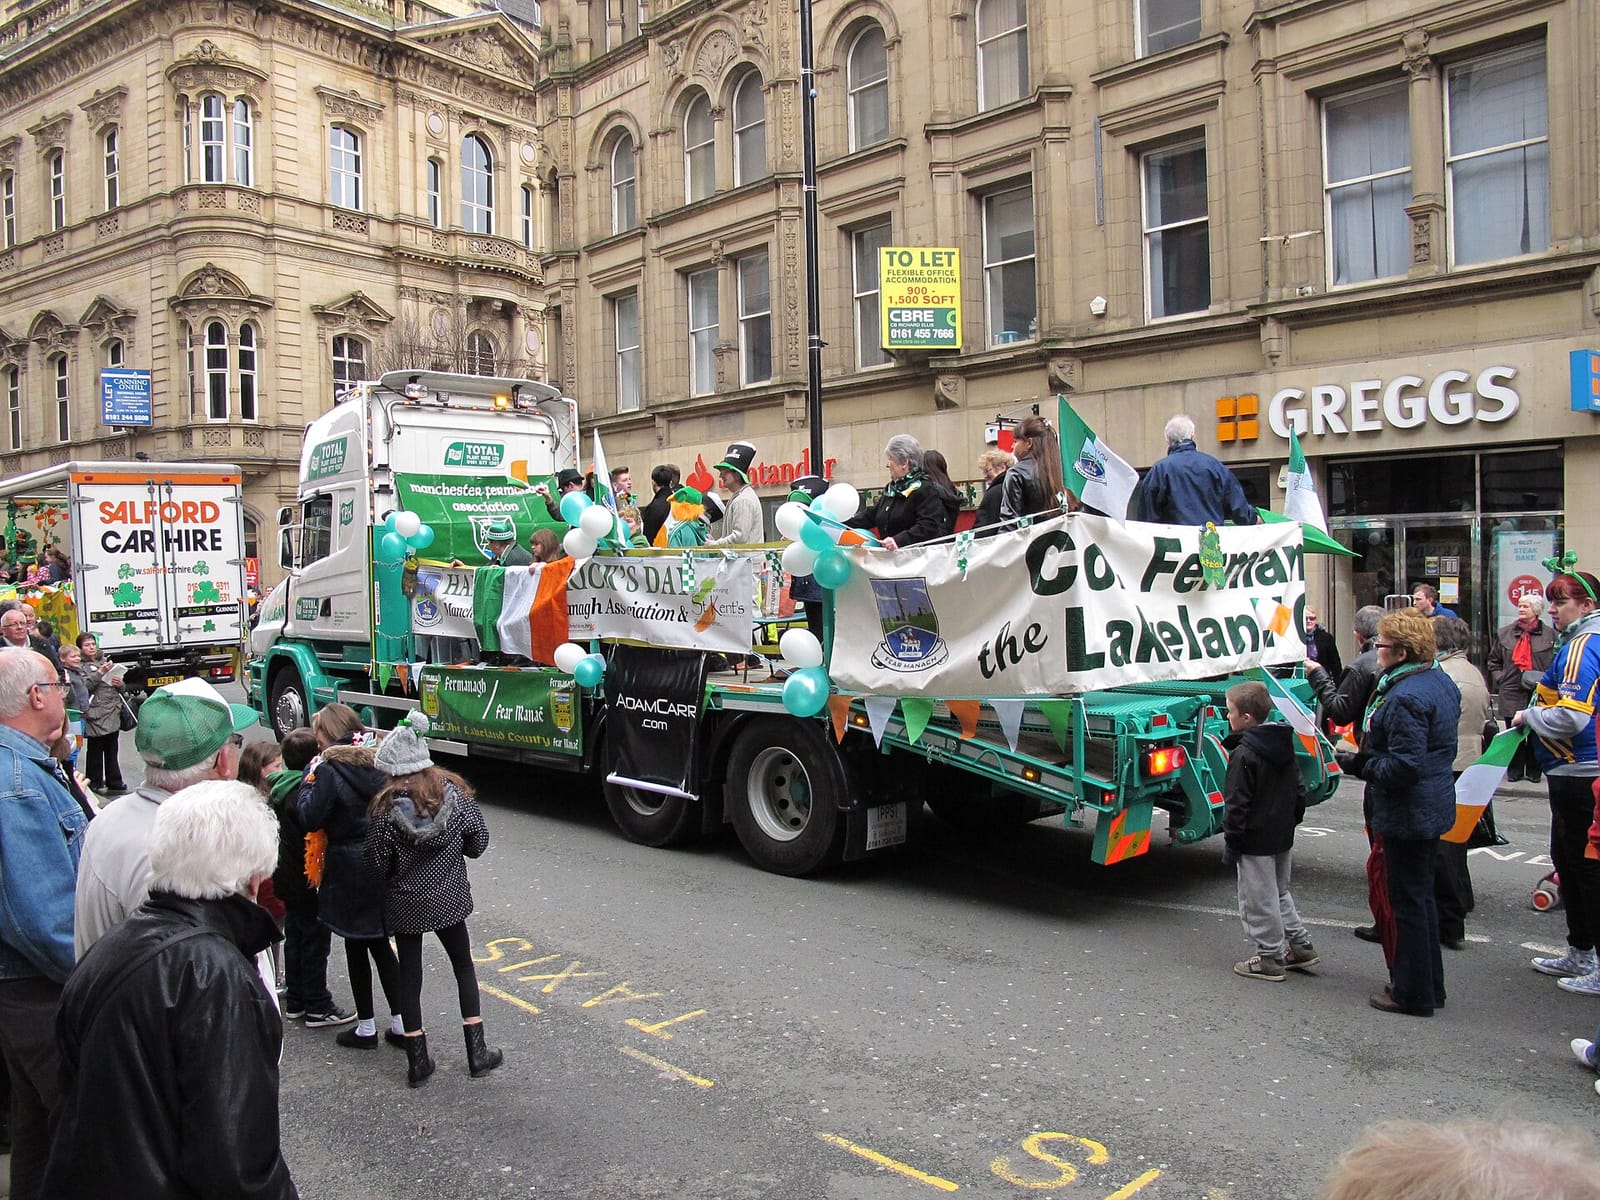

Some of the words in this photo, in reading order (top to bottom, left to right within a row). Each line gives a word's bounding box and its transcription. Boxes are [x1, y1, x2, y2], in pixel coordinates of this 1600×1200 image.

[885, 251, 913, 267] TO
[920, 251, 955, 267] LET
[907, 286, 928, 295] 900
[888, 296, 919, 305] 1,500
[923, 296, 955, 304] SQFT
[889, 310, 934, 322] CBRE
[891, 329, 912, 338] 0161
[914, 329, 931, 338] 455
[933, 329, 954, 338] 7666
[105, 400, 113, 413] TO
[1268, 366, 1520, 439] GREGGS
[322, 442, 344, 460] TOTAL
[466, 445, 499, 456] TOTAL
[719, 448, 836, 488] ntandr
[410, 483, 482, 496] manchester
[99, 501, 220, 524] SALFORD
[452, 501, 520, 512] association
[101, 530, 155, 553] CAR
[164, 529, 222, 552] HIRE
[1140, 537, 1305, 593] Feman
[677, 605, 688, 622] &
[978, 621, 1048, 679] the
[445, 676, 487, 698] Fermanagh
[642, 719, 668, 731] .com
